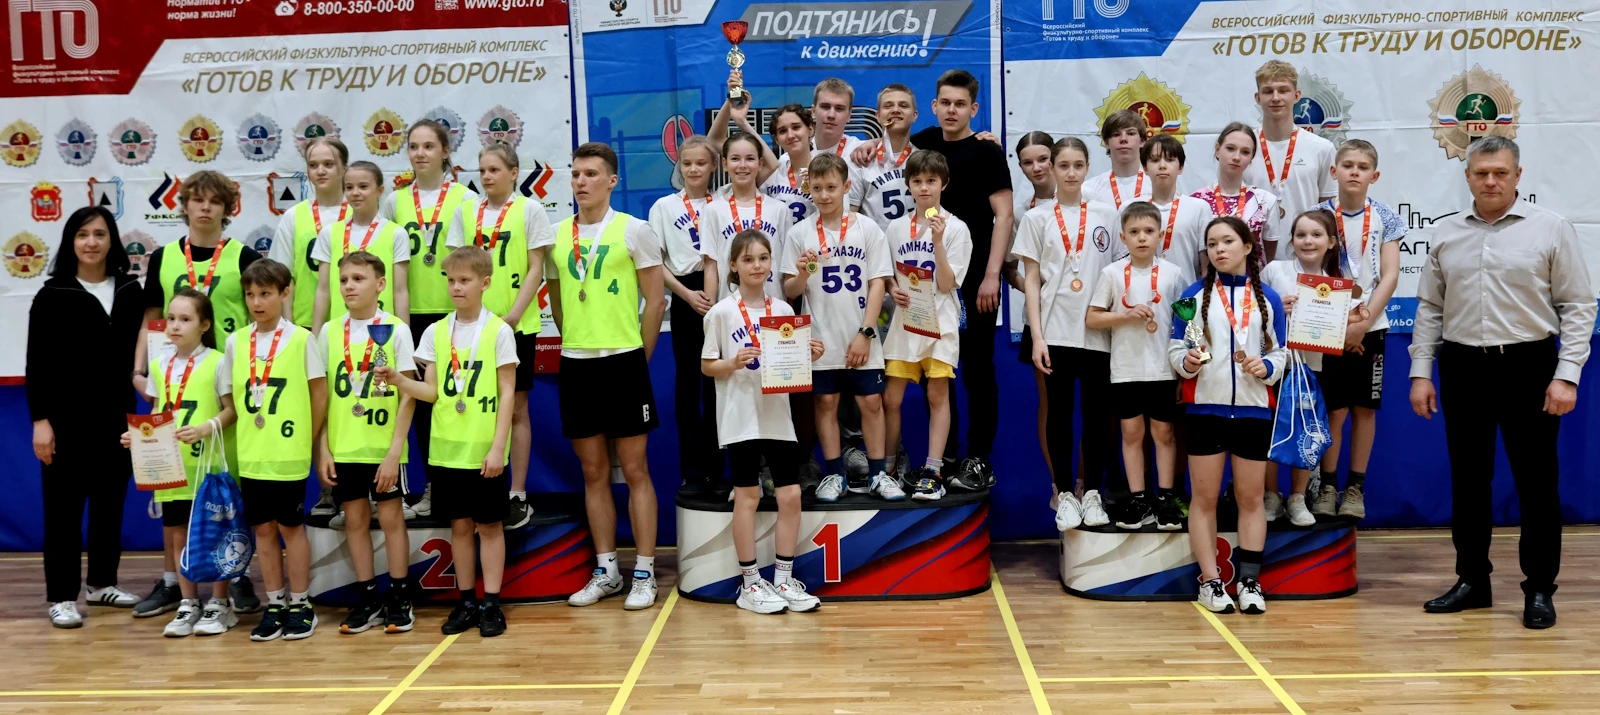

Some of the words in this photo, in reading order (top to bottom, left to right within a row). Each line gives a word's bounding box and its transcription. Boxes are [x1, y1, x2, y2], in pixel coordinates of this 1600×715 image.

[167, 12, 199, 21] норма
[201, 8, 236, 19] жизни!
[304, 0, 415, 15] 8-800-350-00-00
[1211, 13, 1315, 29] ВСЕРОССИЙСКИЙ
[1323, 9, 1508, 25] ФИЗКУЛЬТУРНО-СПОРТИВНЫЙ
[1515, 11, 1585, 22] КОМПЛЕКС
[9, 0, 99, 61] ГТО
[752, 10, 921, 39] ПОДТЯНИСЬ
[182, 47, 287, 64] ВСЕРОССИЙСКИЙ
[290, 39, 476, 60] ФИЗКУЛЬТУРНО-СПОРТИВНЫЙ
[479, 39, 548, 53] КОМПЛЕКС
[801, 44, 813, 59] к
[1212, 30, 1306, 57] «ГОТОВ
[1311, 32, 1331, 54] К
[1338, 30, 1419, 56] ТРУДУ
[1424, 29, 1444, 51] И
[1450, 27, 1582, 51] ОБОРОНЕ»
[181, 69, 272, 94] «ГОТОВ
[280, 69, 298, 92] К
[305, 65, 384, 92] ТРУДУ
[386, 64, 407, 87] И
[414, 60, 547, 87] ОБОРОНЕ»
[1466, 122, 1487, 131] ГТО
[403, 221, 444, 255] 67
[568, 245, 610, 280] 67
[511, 273, 520, 289] 2
[607, 279, 619, 295] 4
[821, 263, 863, 294] 53
[223, 317, 236, 333] 3
[334, 360, 376, 399] 67
[443, 360, 483, 397] 67
[244, 376, 287, 415] 67
[478, 396, 496, 413] 11
[280, 420, 294, 438] 6
[363, 408, 388, 426] 10
[190, 440, 205, 457] 9
[418, 536, 457, 590] 2
[812, 522, 841, 583] 1
